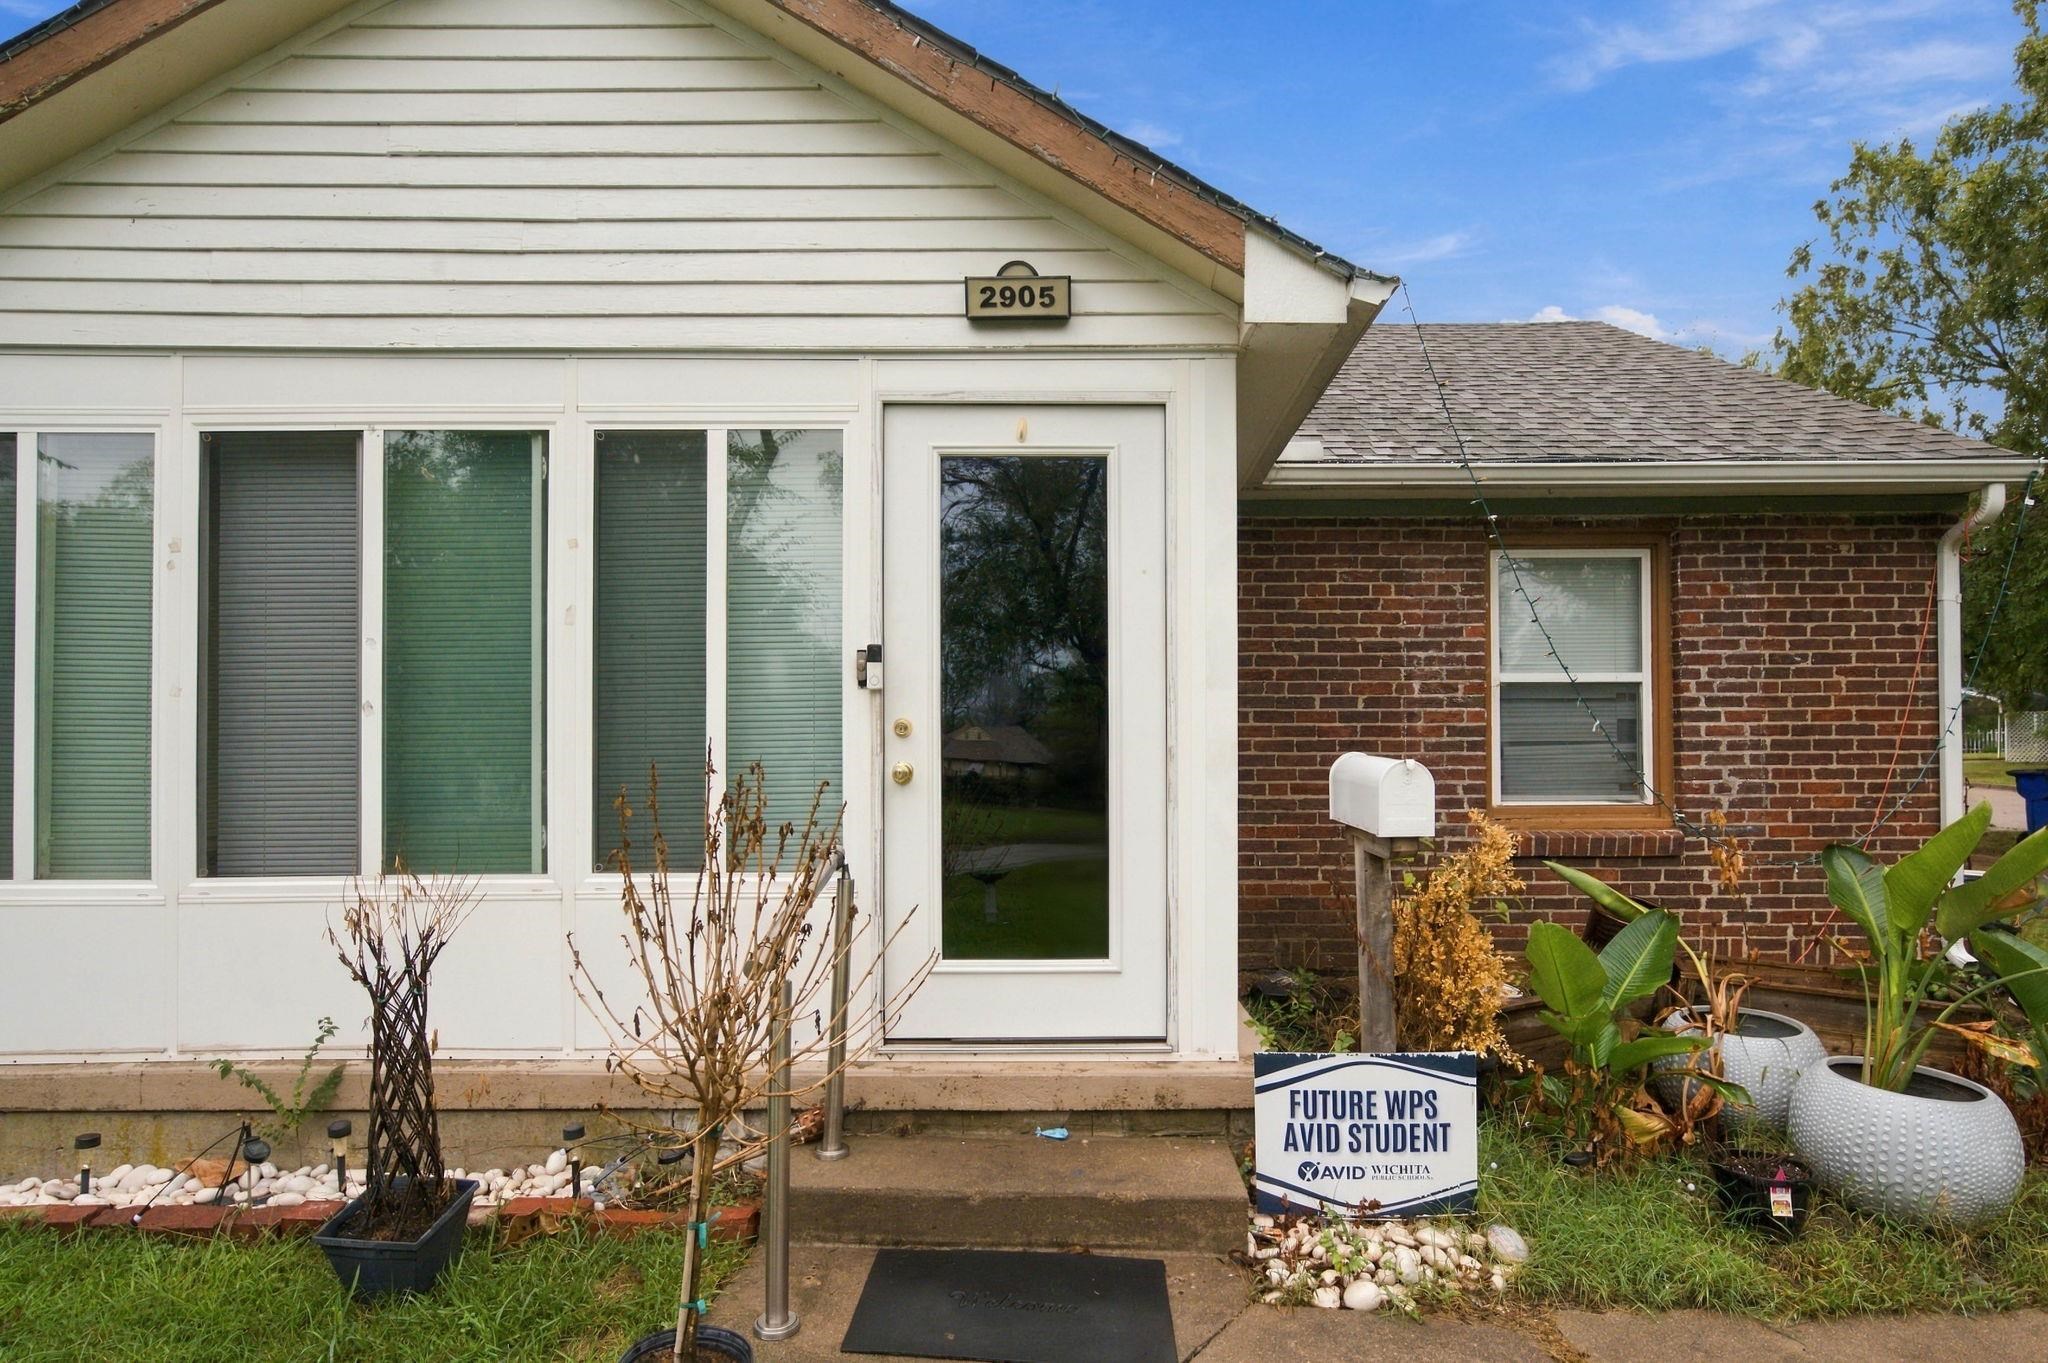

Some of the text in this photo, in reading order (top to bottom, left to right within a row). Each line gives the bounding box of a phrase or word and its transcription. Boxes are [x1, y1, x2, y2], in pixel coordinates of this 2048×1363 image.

[979, 285, 1056, 309] 2905
[1289, 1089, 1378, 1120] FUTURE
[1384, 1089, 1438, 1120] WPS
[1283, 1122, 1451, 1153] AVID STUDENT
[1320, 1165, 1366, 1180] AVID
[1371, 1164, 1431, 1175] WICHITA
